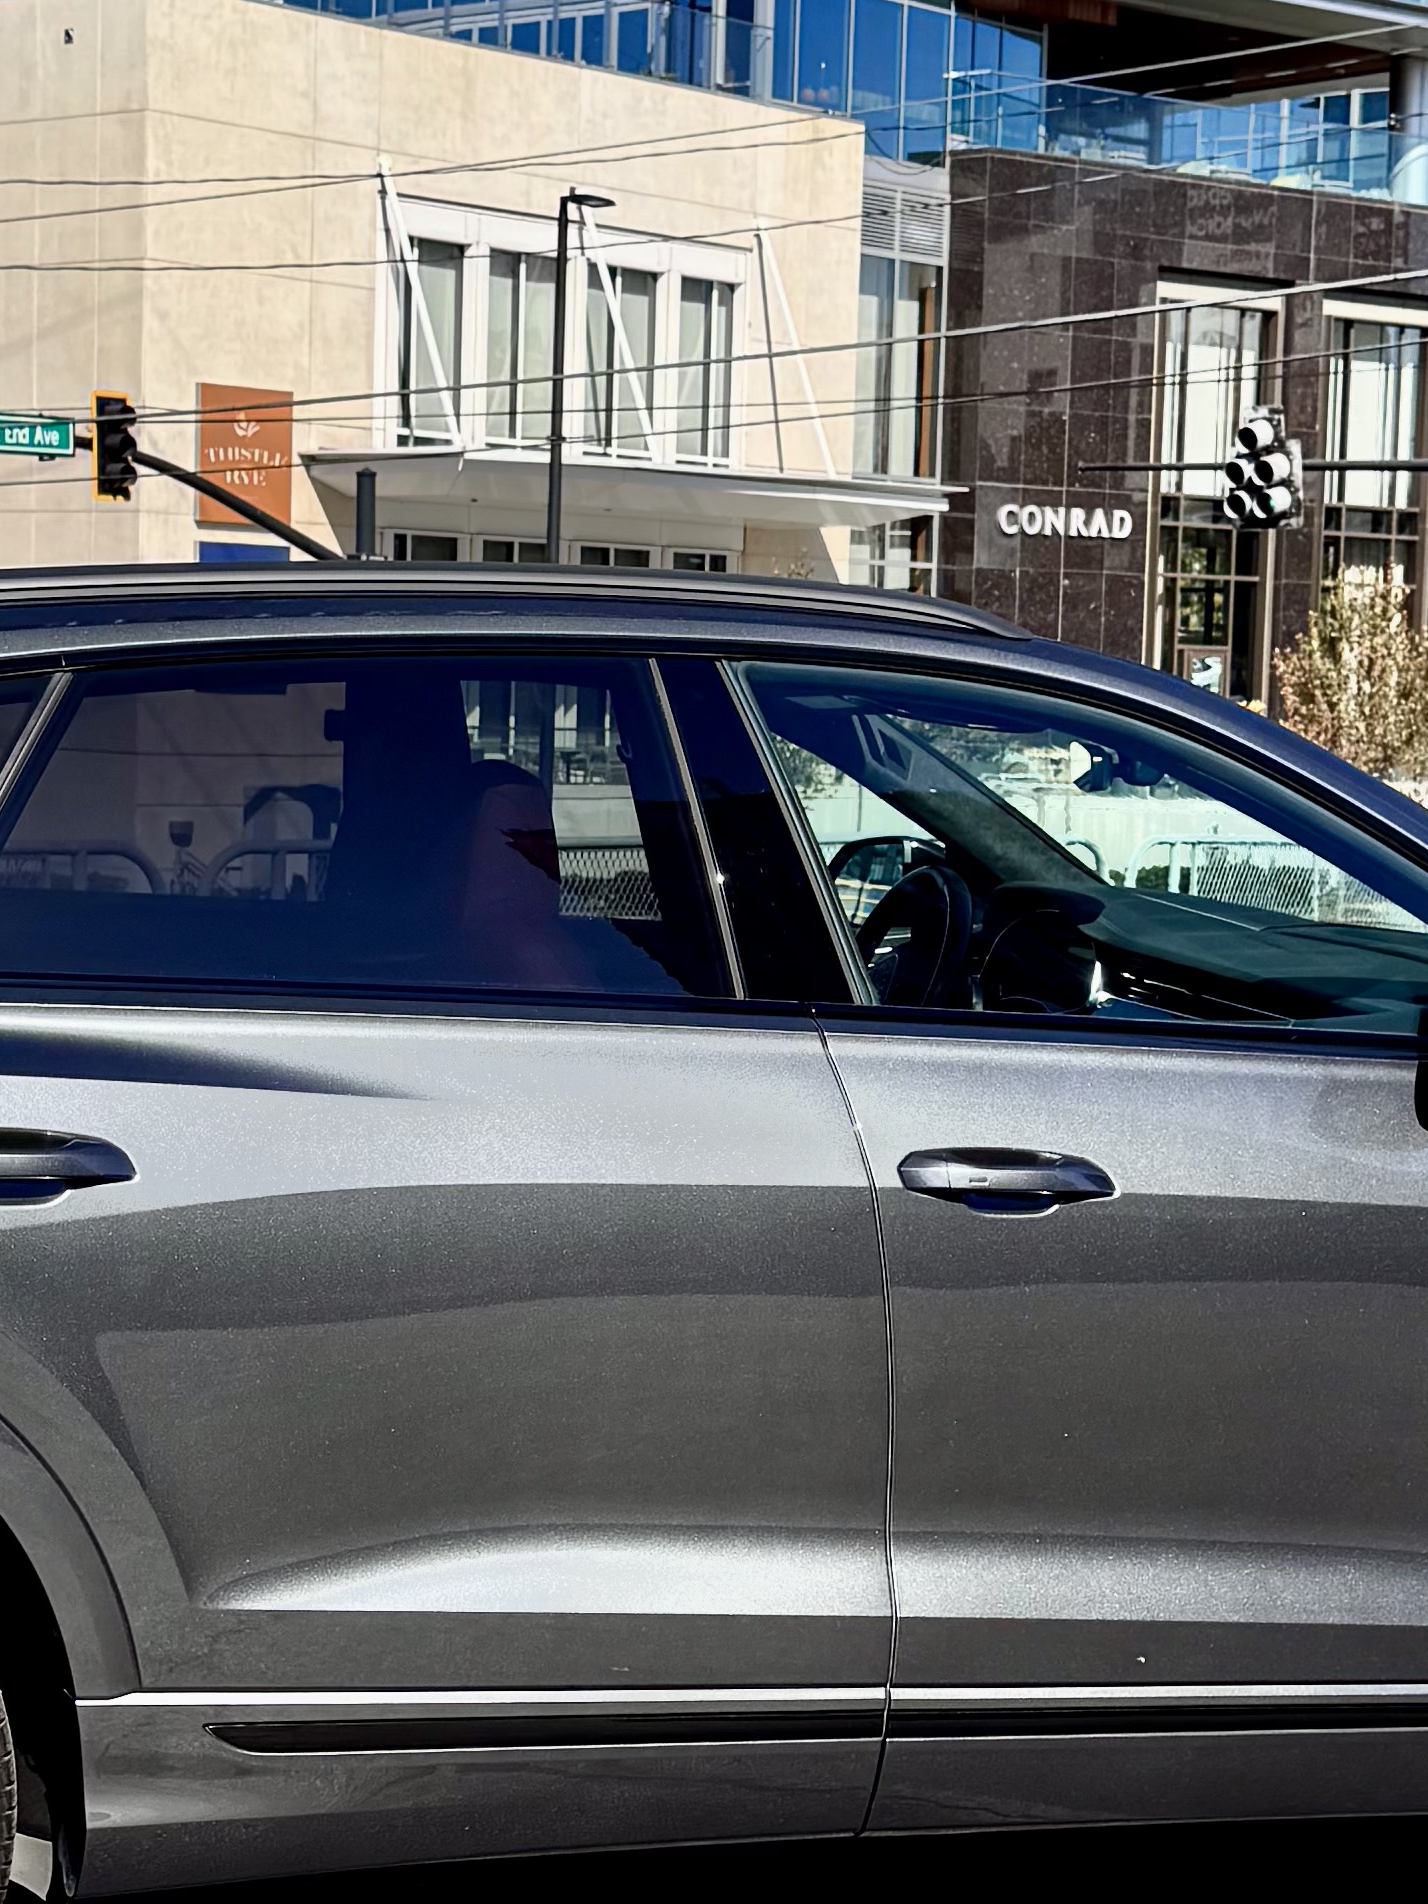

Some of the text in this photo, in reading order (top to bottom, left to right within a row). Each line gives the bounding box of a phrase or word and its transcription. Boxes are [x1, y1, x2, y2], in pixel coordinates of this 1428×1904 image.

[4, 427, 30, 444] End
[33, 425, 60, 446] Ave
[996, 503, 1134, 539] CONRAD
